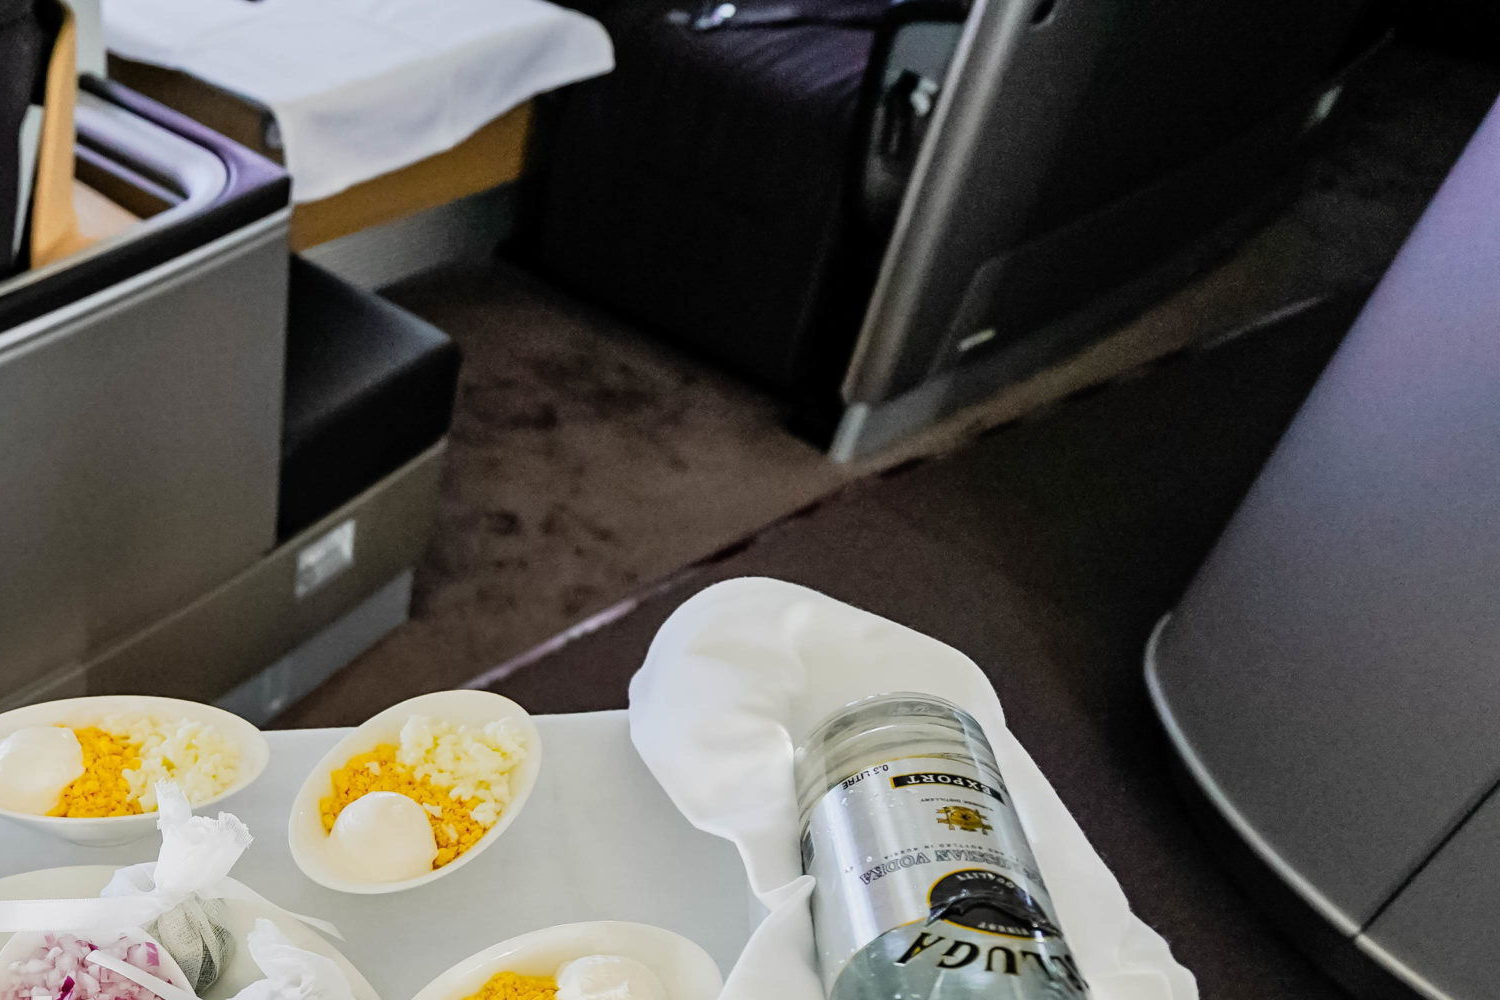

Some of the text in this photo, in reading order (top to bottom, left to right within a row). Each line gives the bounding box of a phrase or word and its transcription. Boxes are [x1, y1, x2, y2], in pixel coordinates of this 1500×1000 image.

[842, 769, 871, 791] LITRE
[906, 774, 993, 797] EXPORT
[859, 852, 931, 886] VODKA
[955, 870, 1016, 889] QUALITY
